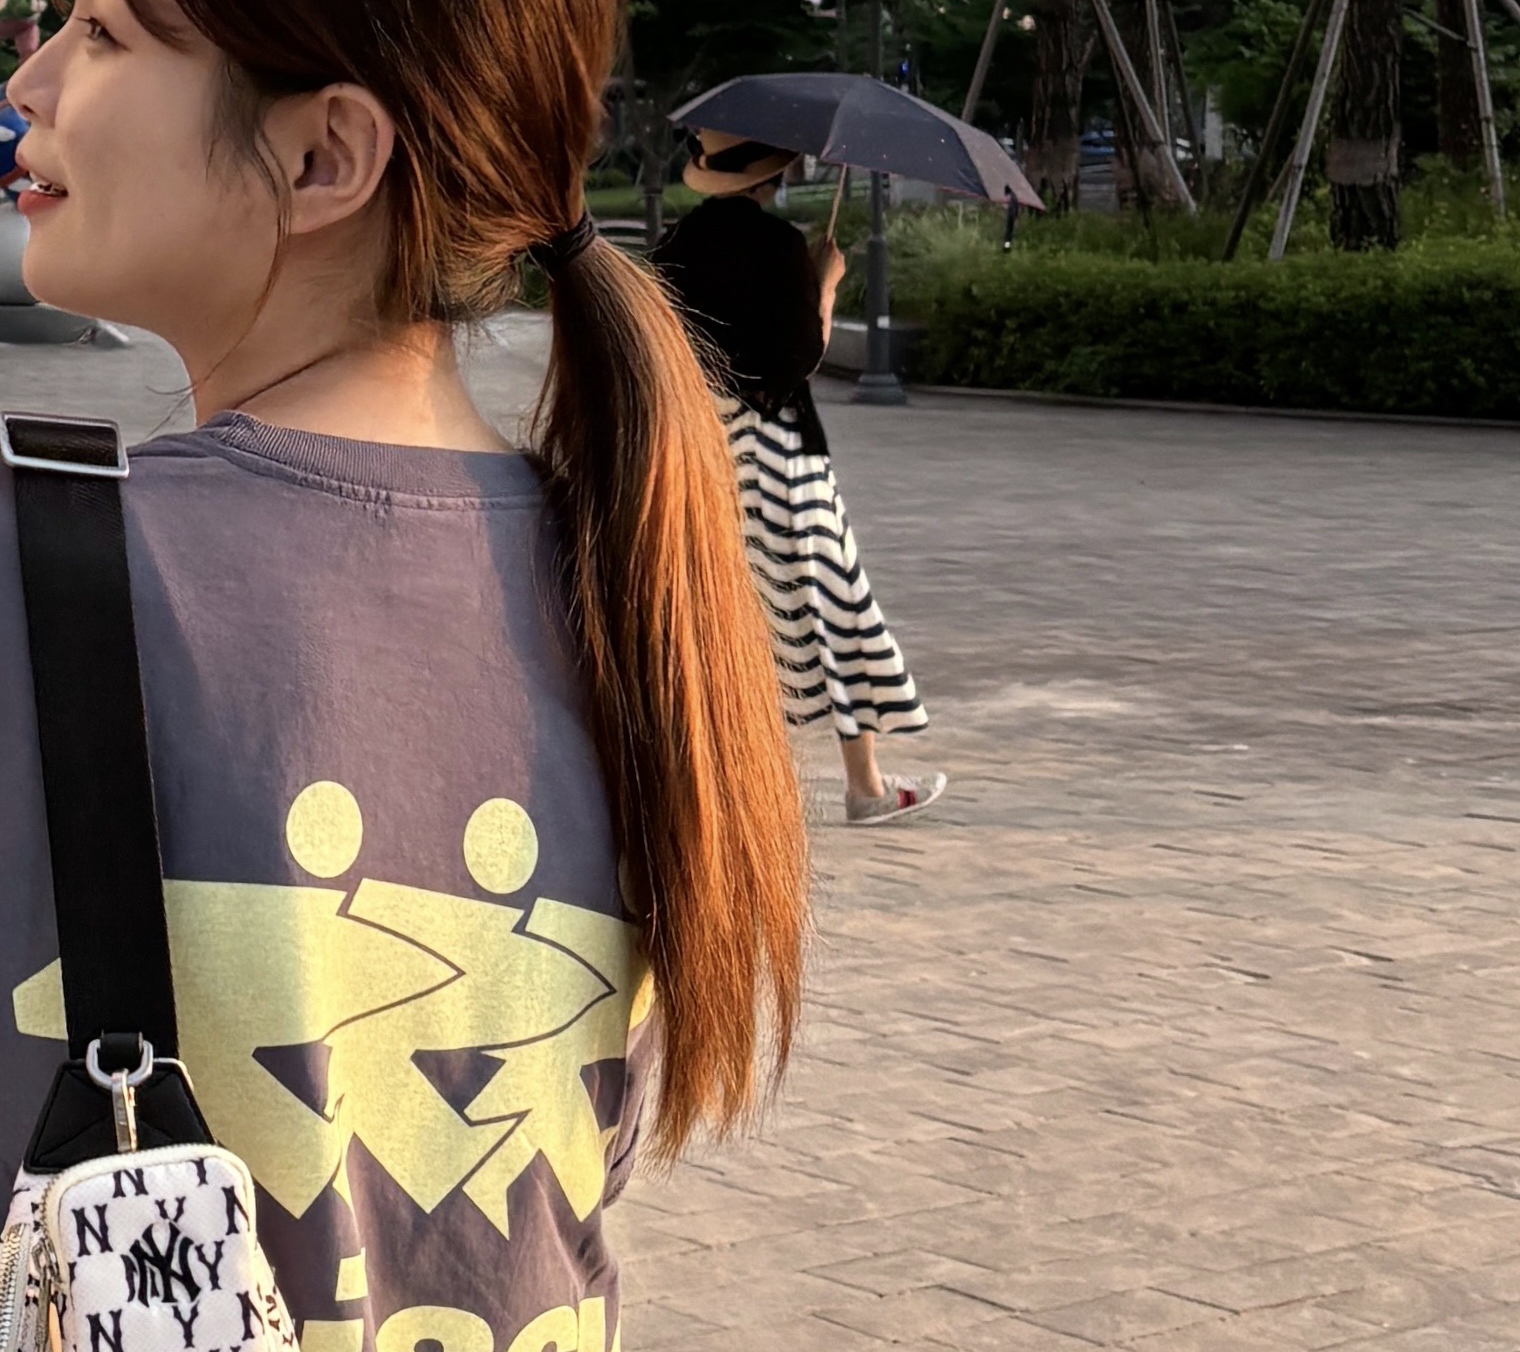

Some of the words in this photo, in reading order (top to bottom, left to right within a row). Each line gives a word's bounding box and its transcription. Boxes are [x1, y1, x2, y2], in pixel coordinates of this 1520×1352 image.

[71, 1203, 114, 1258] N
[127, 1220, 203, 1307] NY
[194, 1239, 225, 1291] Y
[171, 1301, 199, 1349] Y
